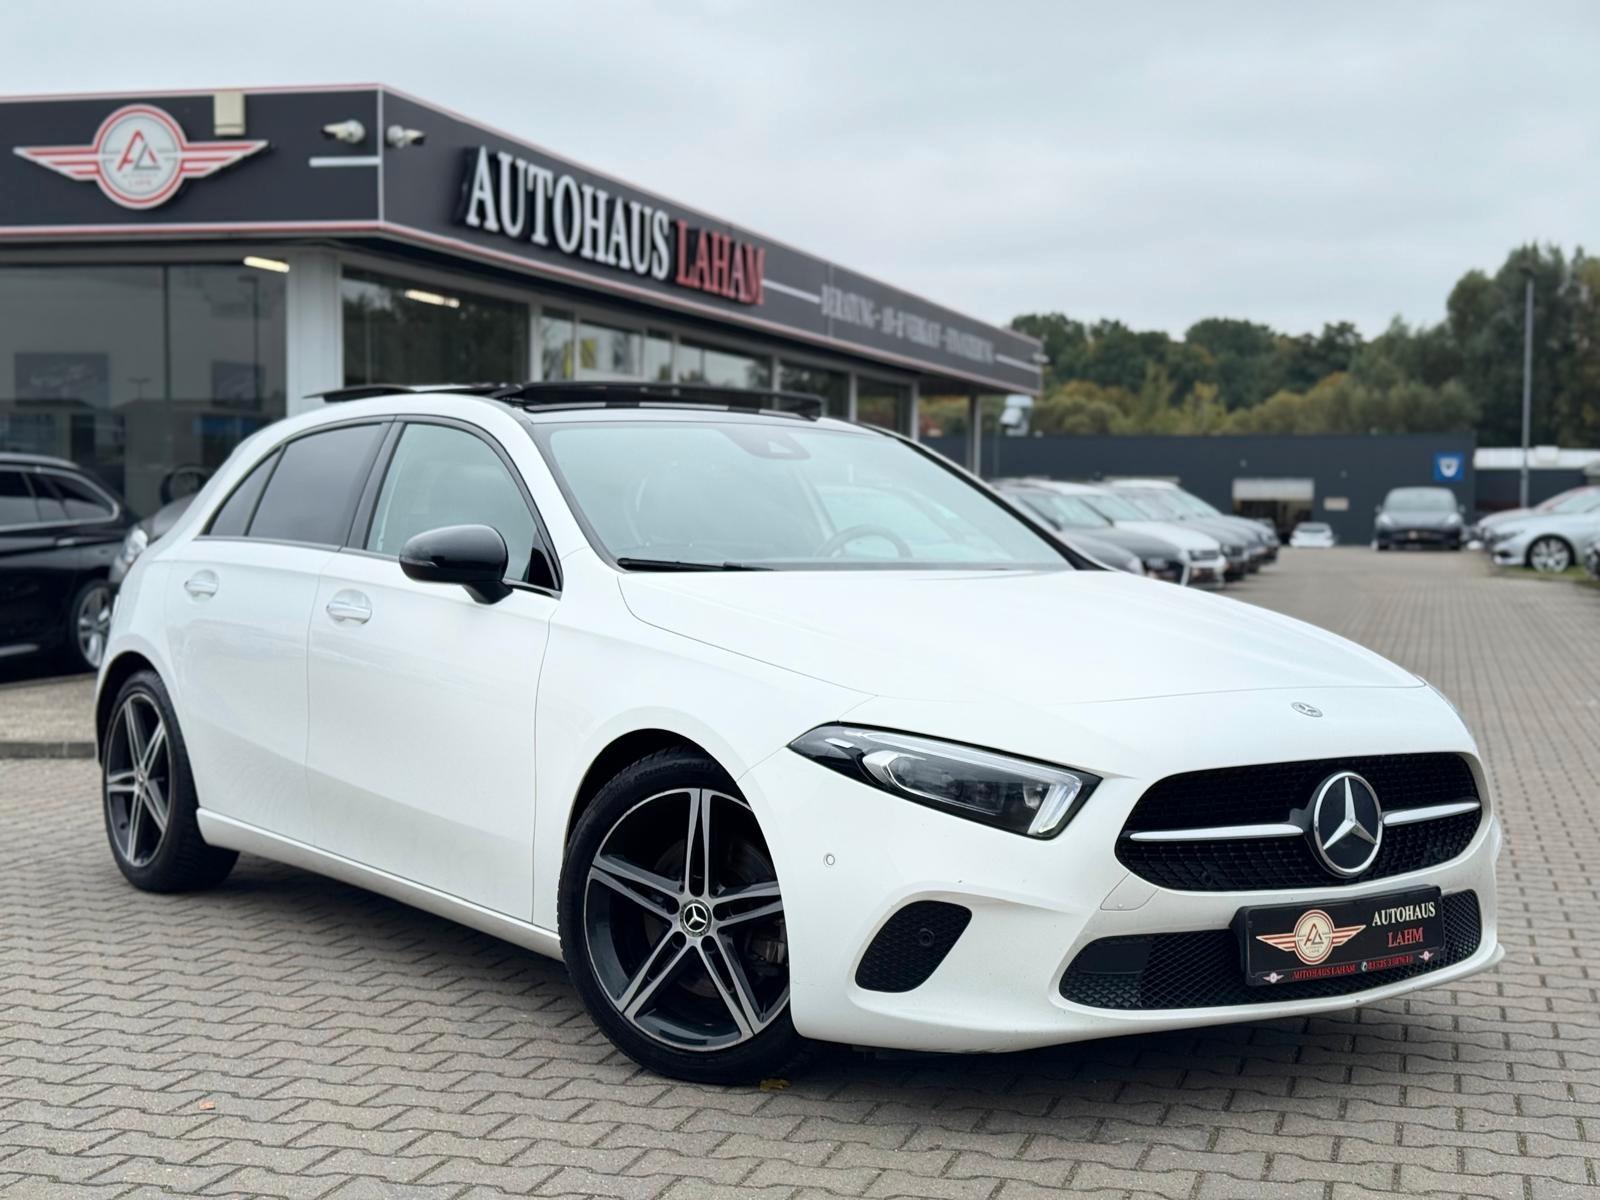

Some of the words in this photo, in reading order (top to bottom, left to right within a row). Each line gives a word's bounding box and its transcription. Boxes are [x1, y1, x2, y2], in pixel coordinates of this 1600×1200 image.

[465, 145, 671, 281] AUTOHAUS
[675, 218, 765, 305] LAHAM
[1372, 901, 1436, 926] AUTOHAUS
[1388, 927, 1423, 947] LAHM
[1291, 966, 1331, 980] AUTOHAUS
